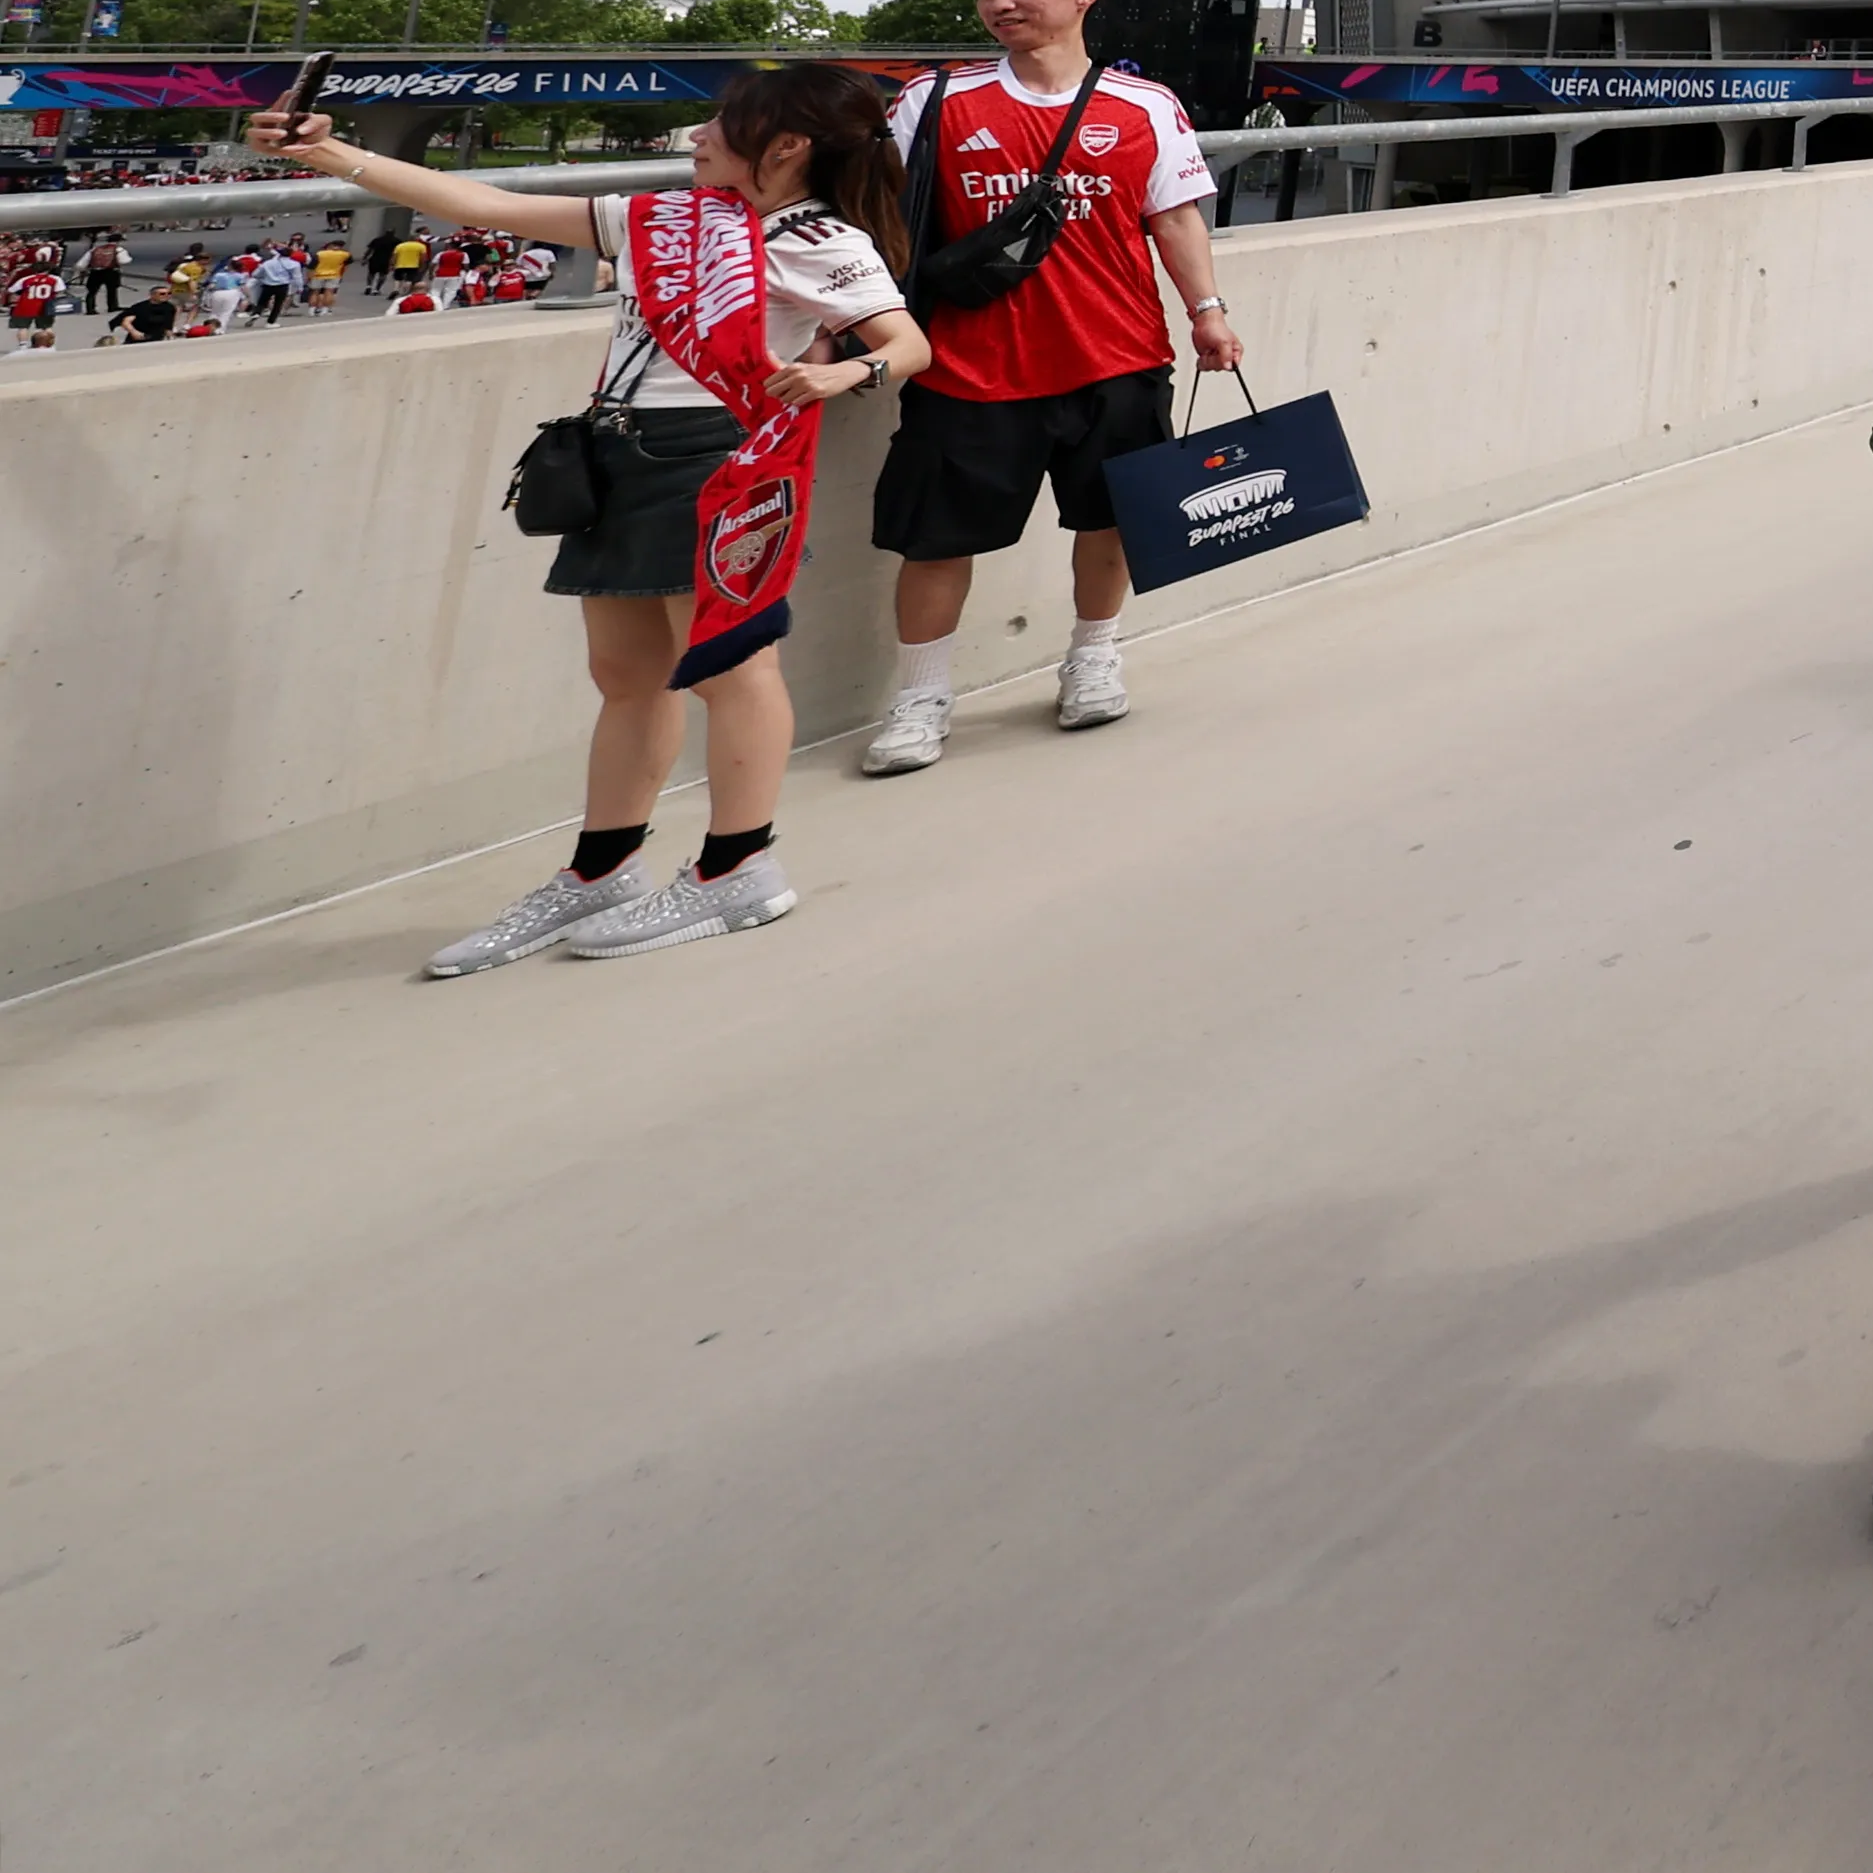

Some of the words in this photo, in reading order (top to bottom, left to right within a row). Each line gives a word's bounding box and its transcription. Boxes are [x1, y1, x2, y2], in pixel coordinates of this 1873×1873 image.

[1413, 20, 1442, 47] B
[319, 73, 481, 98] BUDAPEST
[473, 72, 518, 94] 26
[534, 72, 667, 92] FINAL
[1551, 77, 1600, 97] UEFA
[1605, 77, 1715, 99] CHAMPIONS
[1720, 78, 1792, 100] LEAGUE
[960, 168, 1111, 199] Emites
[643, 189, 695, 267] DAPEST
[817, 264, 885, 295] RWANDA
[826, 258, 865, 280] VISIT
[28, 284, 52, 299] 10
[656, 270, 692, 302] 26
[662, 302, 753, 410] FINAL
[719, 491, 783, 536] Arsenal
[1187, 506, 1272, 548] BUDAPEST
[1271, 497, 1295, 520] 26
[1220, 526, 1271, 546] FINAL
